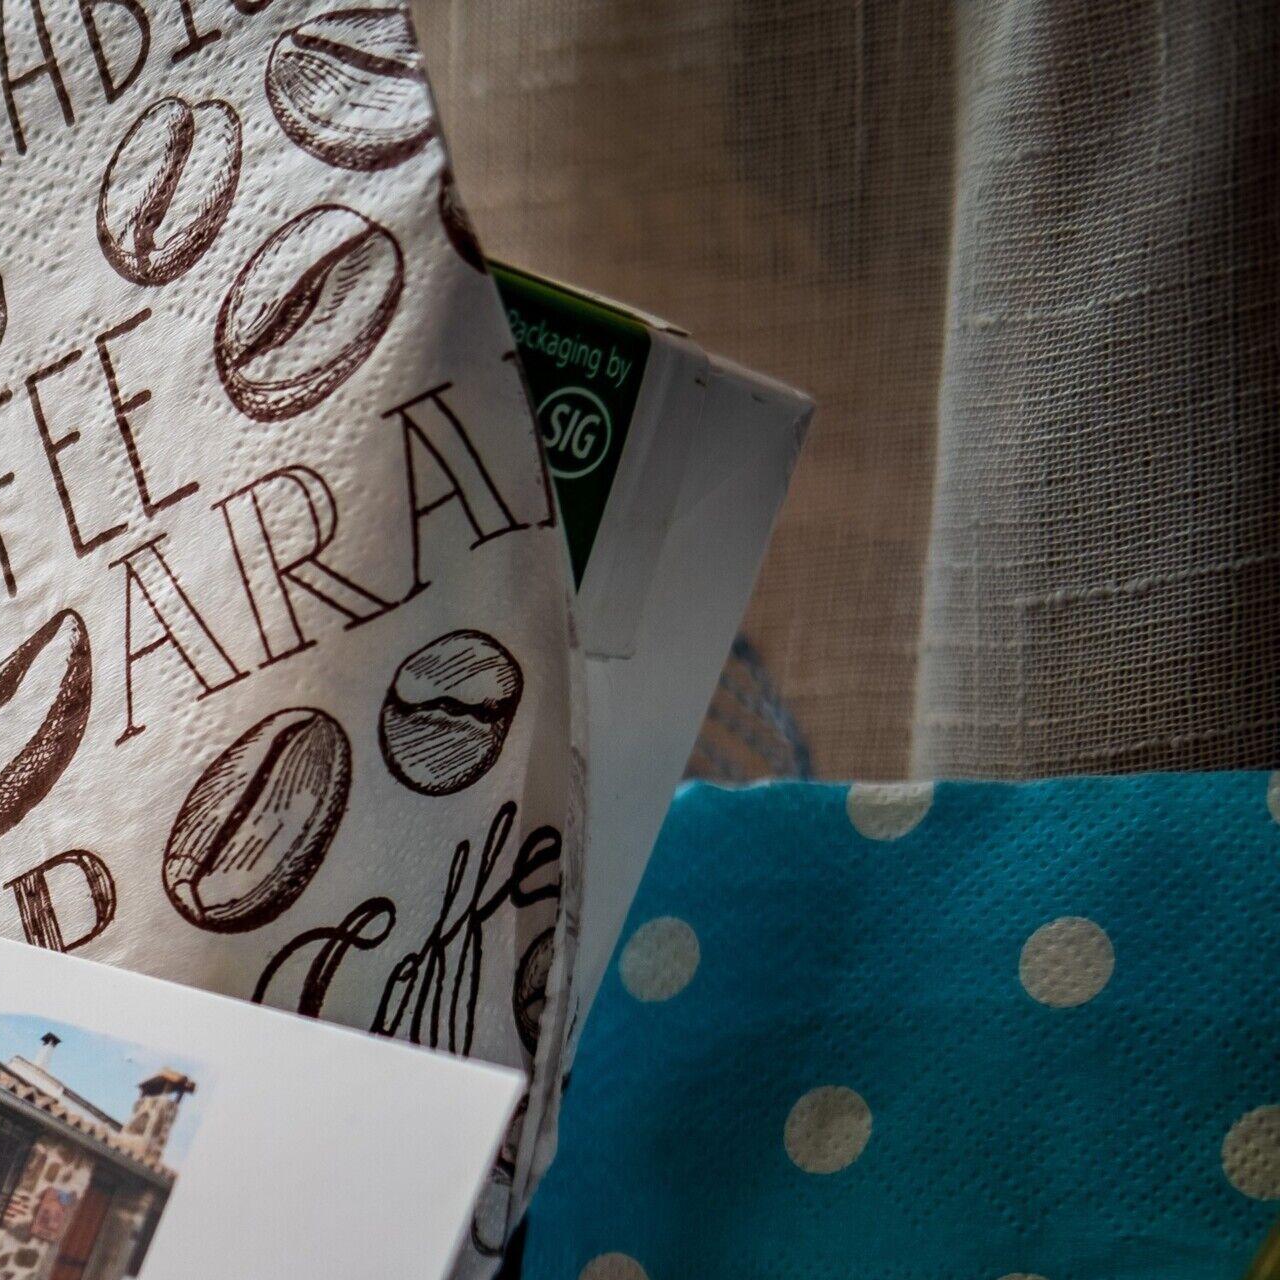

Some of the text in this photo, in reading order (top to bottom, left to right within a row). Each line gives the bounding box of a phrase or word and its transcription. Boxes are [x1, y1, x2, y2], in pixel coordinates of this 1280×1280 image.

[605, 346, 633, 388] by
[543, 402, 600, 460] SIG
[108, 352, 557, 747] ARA
